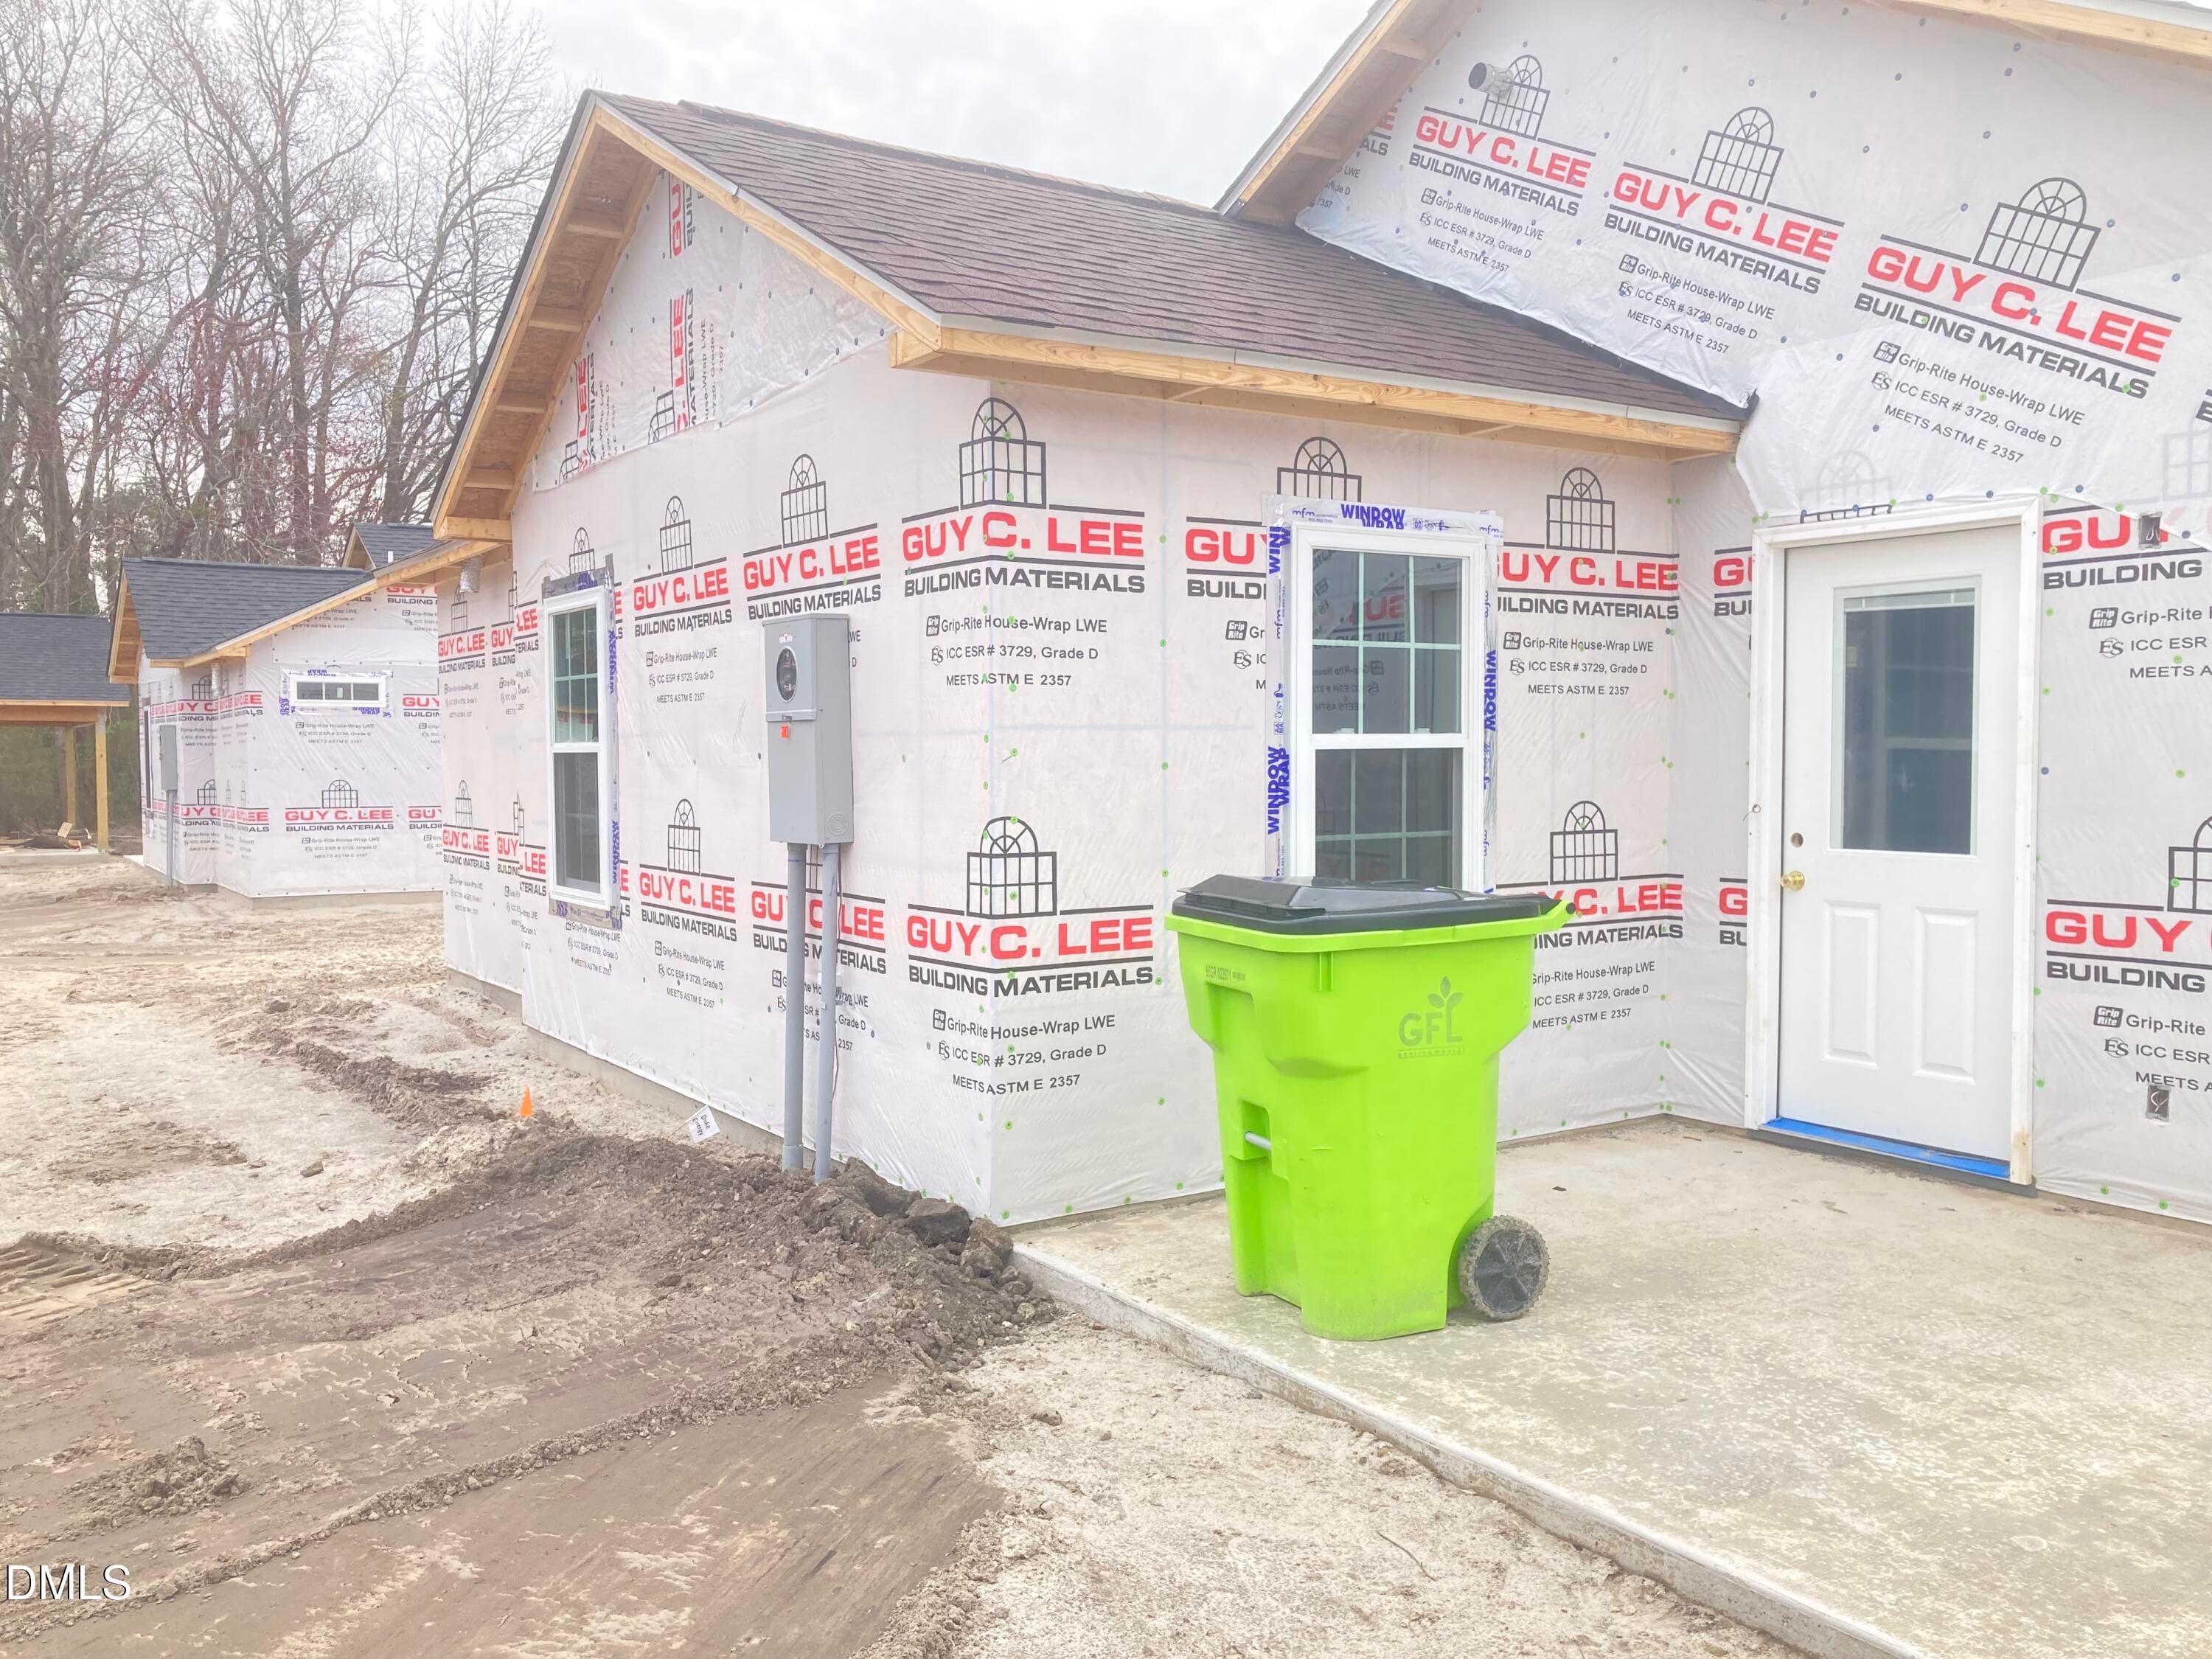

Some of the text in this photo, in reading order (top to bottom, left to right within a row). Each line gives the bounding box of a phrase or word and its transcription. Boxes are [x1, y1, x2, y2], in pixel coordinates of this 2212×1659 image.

[1416, 116, 1591, 188] GUY C. LEE
[1409, 153, 1579, 216] BUILDING MATERIALS
[1436, 196, 1544, 240] Grip-Rite House-Wrap LWE
[1614, 173, 1839, 262] GUY C. LEE
[1428, 237, 1509, 271] MEETS ASTM E 2357
[1434, 218, 1449, 229] ICC
[1451, 223, 1467, 236] ESR
[1498, 241, 1523, 255] Grade
[1524, 249, 1531, 258] D
[1604, 213, 1820, 294] BUILDING MATERIALS
[1638, 264, 1775, 319] Grip-Rite House-Wrap LWE
[1868, 247, 2173, 363] GUY C. LEE
[673, 295, 684, 388] LEE
[1854, 293, 2149, 399] BUILDING MATERIALS
[1899, 353, 2085, 425] Grip-Rite House-Wrap LWE
[1895, 380, 2062, 447] ICC ESR # 3729, Grade D
[1885, 405, 2024, 462] MEETS ASTM E 2357
[1340, 504, 1405, 521] WINDOW
[902, 512, 1144, 561] GUY C. LEE
[2042, 514, 2168, 554] GU
[743, 535, 880, 590] GUY C. LEE
[1497, 552, 1679, 591] UY C. LEE
[2043, 560, 2202, 590] BUILDING
[634, 580, 668, 611] GUY
[673, 577, 690, 603] C.
[694, 568, 729, 601] LEE
[905, 567, 1144, 597] BUILDING MATERIALS
[748, 585, 880, 620] BUILDING MATERIALS
[1498, 597, 1679, 619] ILDING MATERIALS
[2121, 608, 2202, 625] Grip-Rite
[635, 609, 732, 637] BUILDING MATERIALS
[942, 615, 1107, 634] Grip-Rite House-Wrap LWE
[947, 644, 1098, 659] ICC ESR # 3729, Grade D
[1523, 637, 1653, 653] Grip-Rite House-Wrap LWE
[2131, 636, 2208, 651] ICC ESR
[947, 673, 1071, 686] MEETS ASTM E 2357
[1529, 661, 1646, 674] ICC ESR # 3729, Grade D
[2130, 666, 2194, 678] MEETS
[1484, 650, 1496, 732] WINDOW
[1528, 684, 1629, 695] MEETS ASTM E 2357
[1268, 746, 1280, 835] WINDOW
[1278, 747, 1290, 807] WRAP
[285, 810, 393, 821] GUY C. LEE
[442, 830, 489, 852] GUY C. LEE
[639, 872, 735, 913] GUY C. LEE
[1573, 883, 1683, 916] C. LEE
[641, 909, 737, 942] BUILDING MATERIALS
[841, 904, 885, 940] LEE
[907, 915, 1153, 960] GUY C. LEE
[1578, 924, 1683, 945] MATERIALS
[2045, 911, 2193, 953] GUY
[909, 965, 1152, 997] BUILDING MATERIALS
[2047, 961, 2205, 992] BUILDING
[947, 1015, 1115, 1040] Grip-Rite House-Wrap LWE
[1399, 992, 1463, 1046] GFL
[2126, 1015, 2205, 1035] Grip-Rite
[953, 1044, 1106, 1067] ICC ESR # 3729, Grade D
[953, 1074, 1080, 1095] MEETS ASTM E 2357
